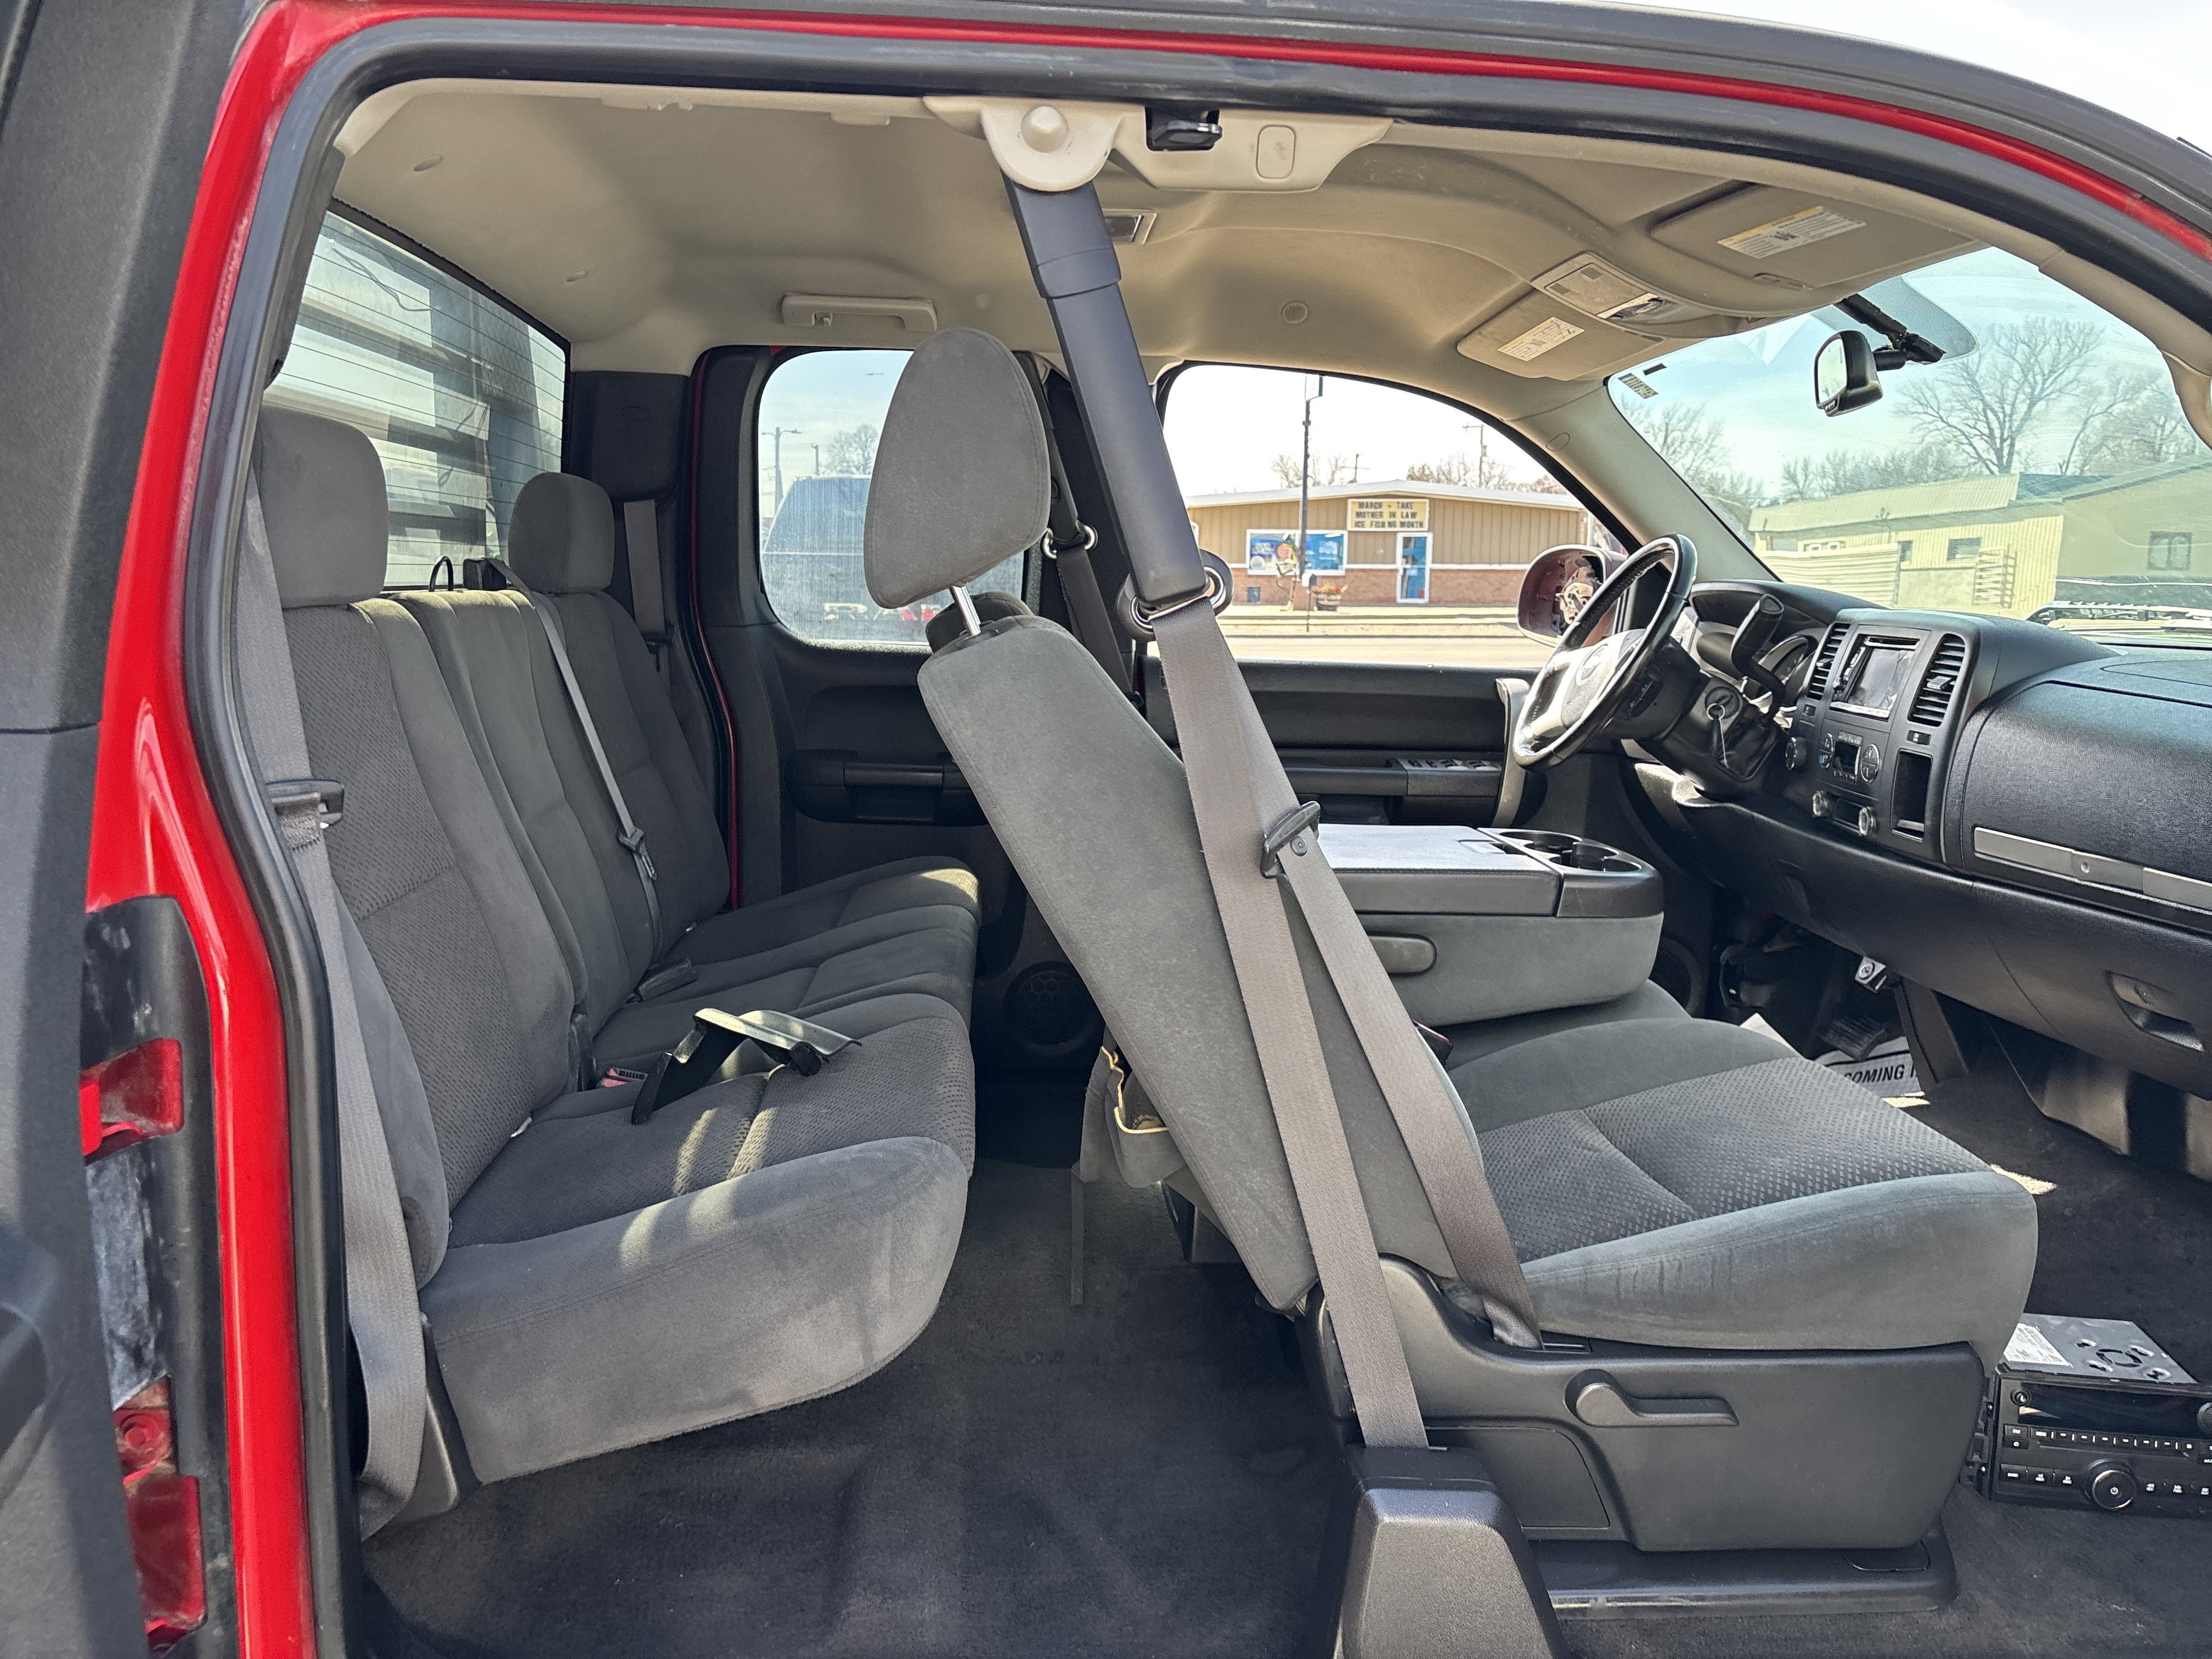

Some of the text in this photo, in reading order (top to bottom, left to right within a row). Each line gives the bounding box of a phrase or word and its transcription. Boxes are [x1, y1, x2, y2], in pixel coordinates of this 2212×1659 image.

[1358, 501, 1383, 509] MARCH
[1397, 501, 1414, 509] TAKE
[1401, 511, 1417, 519] LAW
